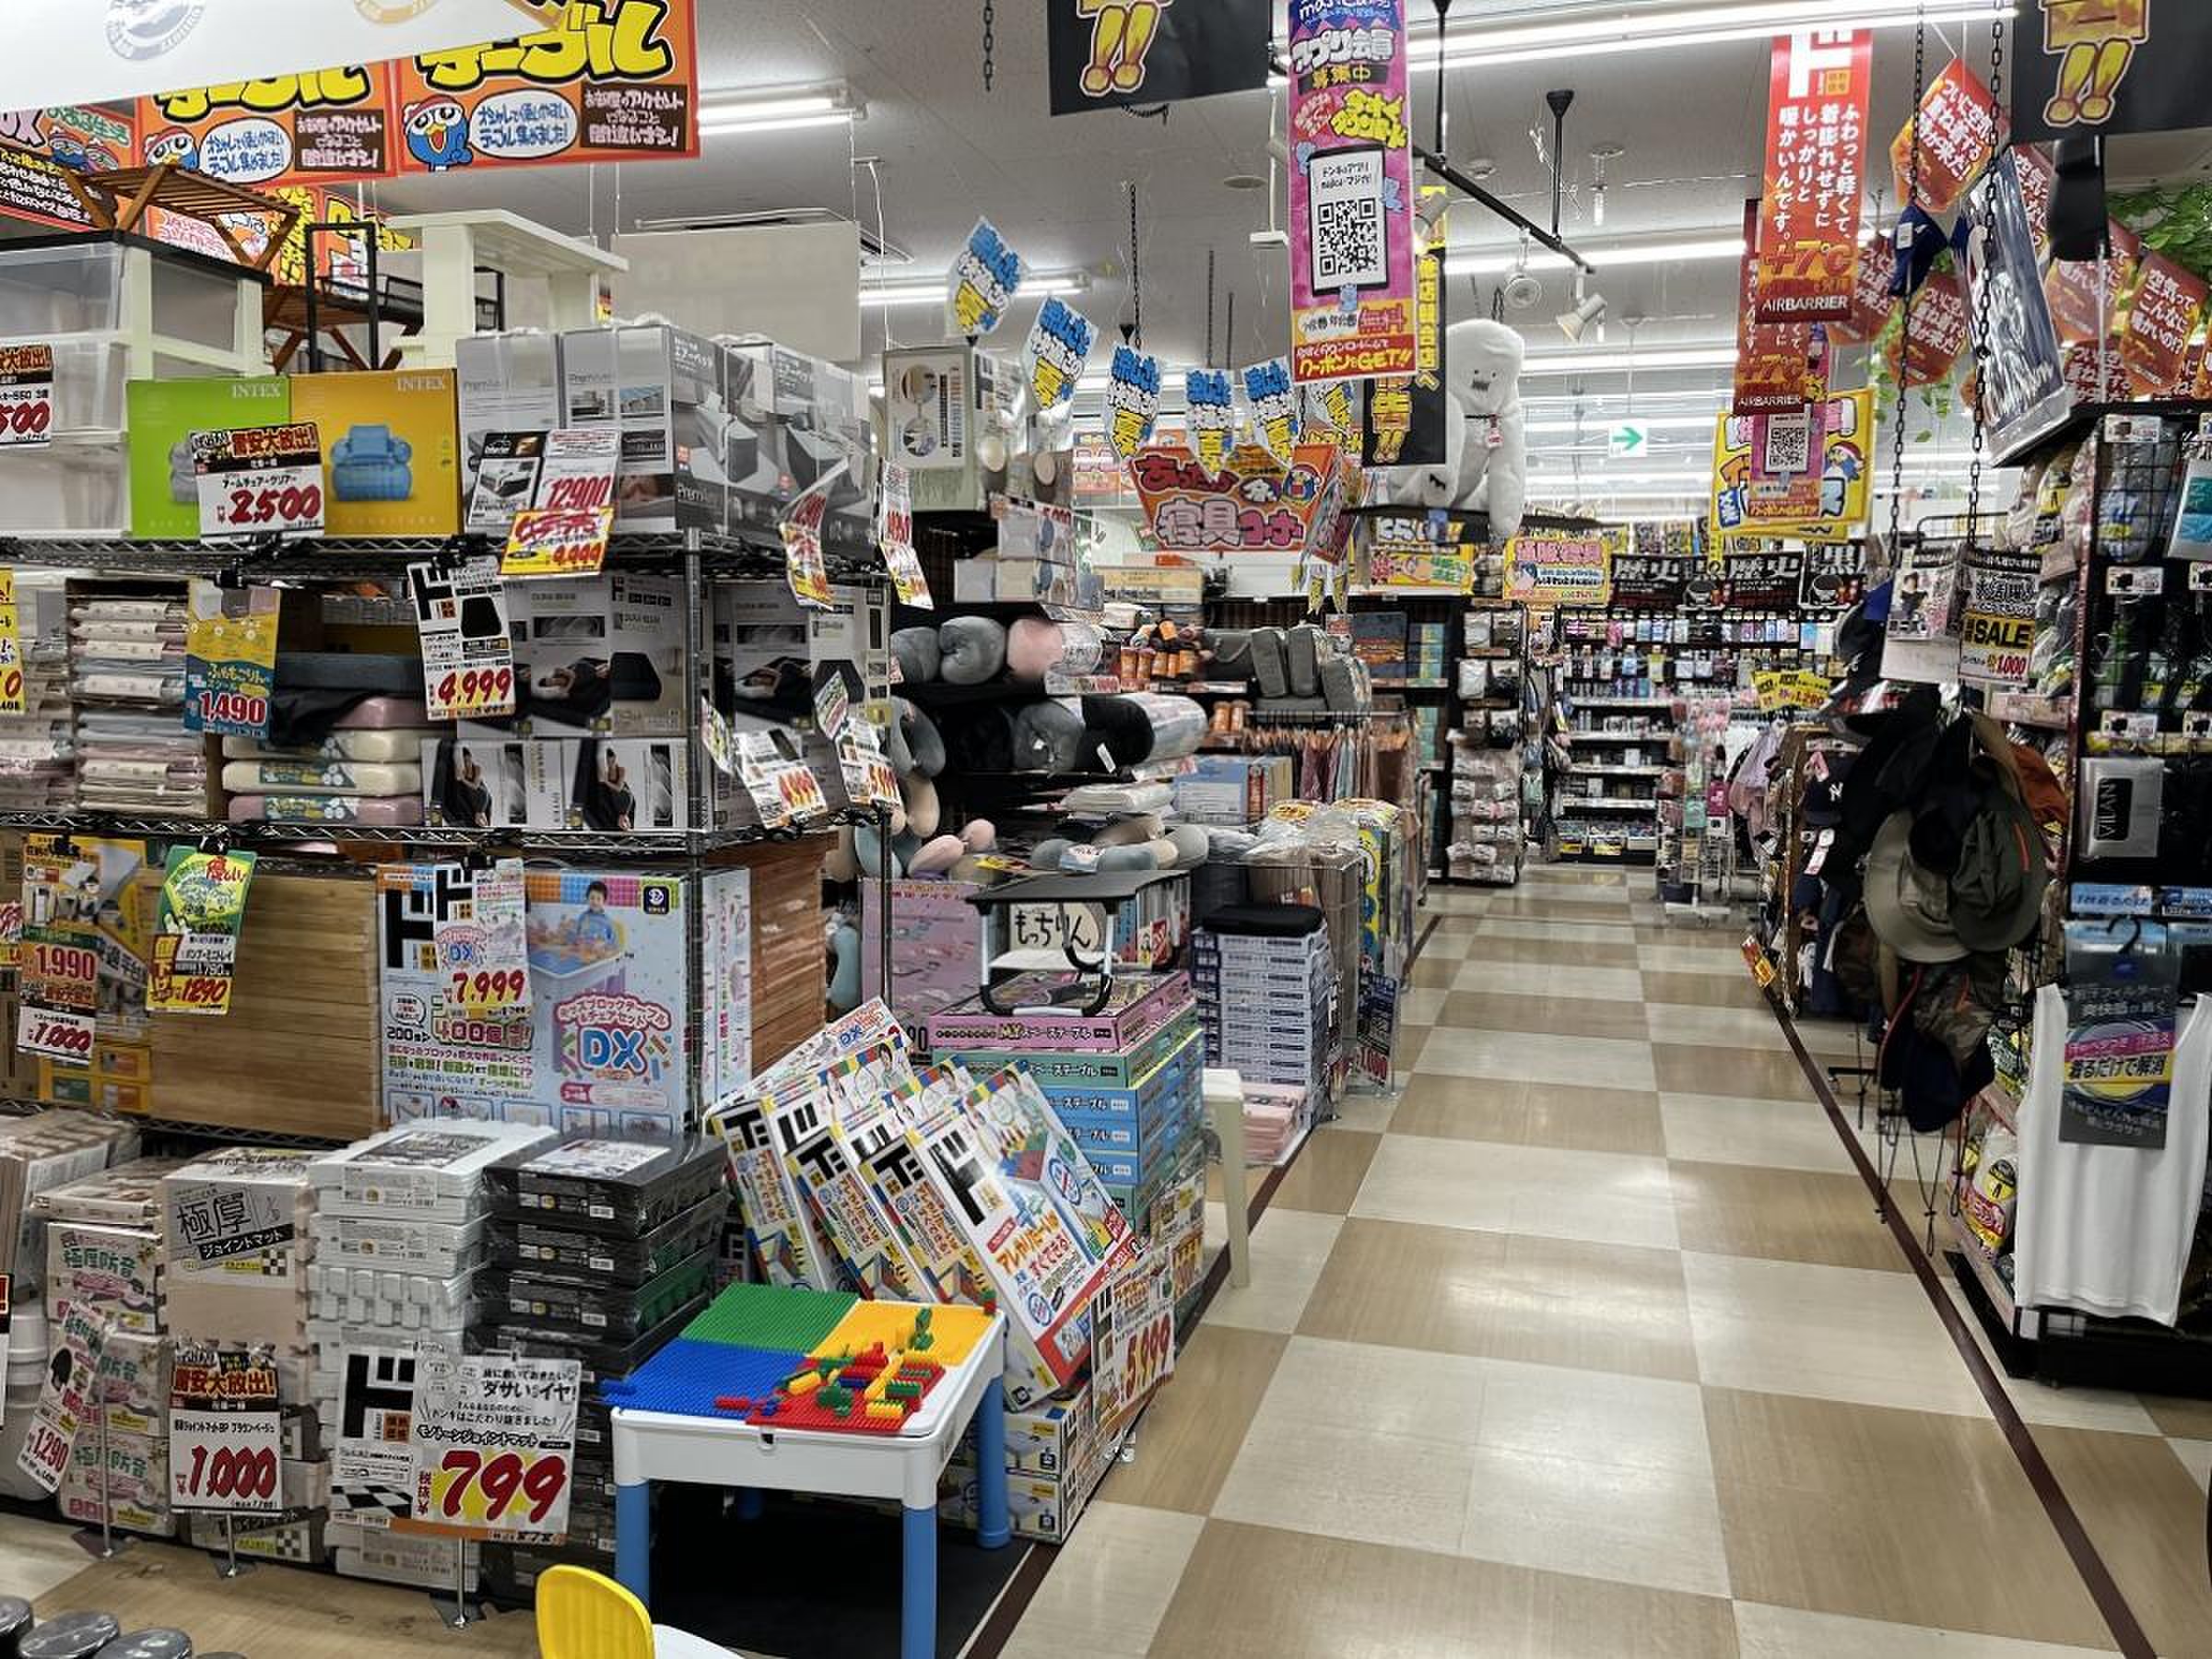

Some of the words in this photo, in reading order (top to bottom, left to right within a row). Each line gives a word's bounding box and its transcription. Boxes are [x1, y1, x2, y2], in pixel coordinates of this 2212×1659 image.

[1772, 105, 1801, 241] 暖かいんです。
[1796, 106, 1818, 204] しっかりと
[1834, 101, 1860, 240] ふわっと軽くて、
[1761, 295, 1849, 312] AIRBARRIER
[230, 382, 282, 398] INTEX
[396, 376, 445, 392] INTEX
[229, 485, 322, 525] 2,500
[1974, 619, 2030, 649] SALE
[438, 667, 512, 707] 4,999
[199, 690, 267, 725] 1,490
[34, 945, 96, 982] 1,990
[452, 970, 526, 1003] 7,999
[580, 1027, 646, 1073] DX
[177, 1192, 252, 1244] 極厚
[200, 1229, 284, 1260] ジョイントマット
[189, 1444, 277, 1500] 1,000
[441, 1448, 567, 1524] 799
